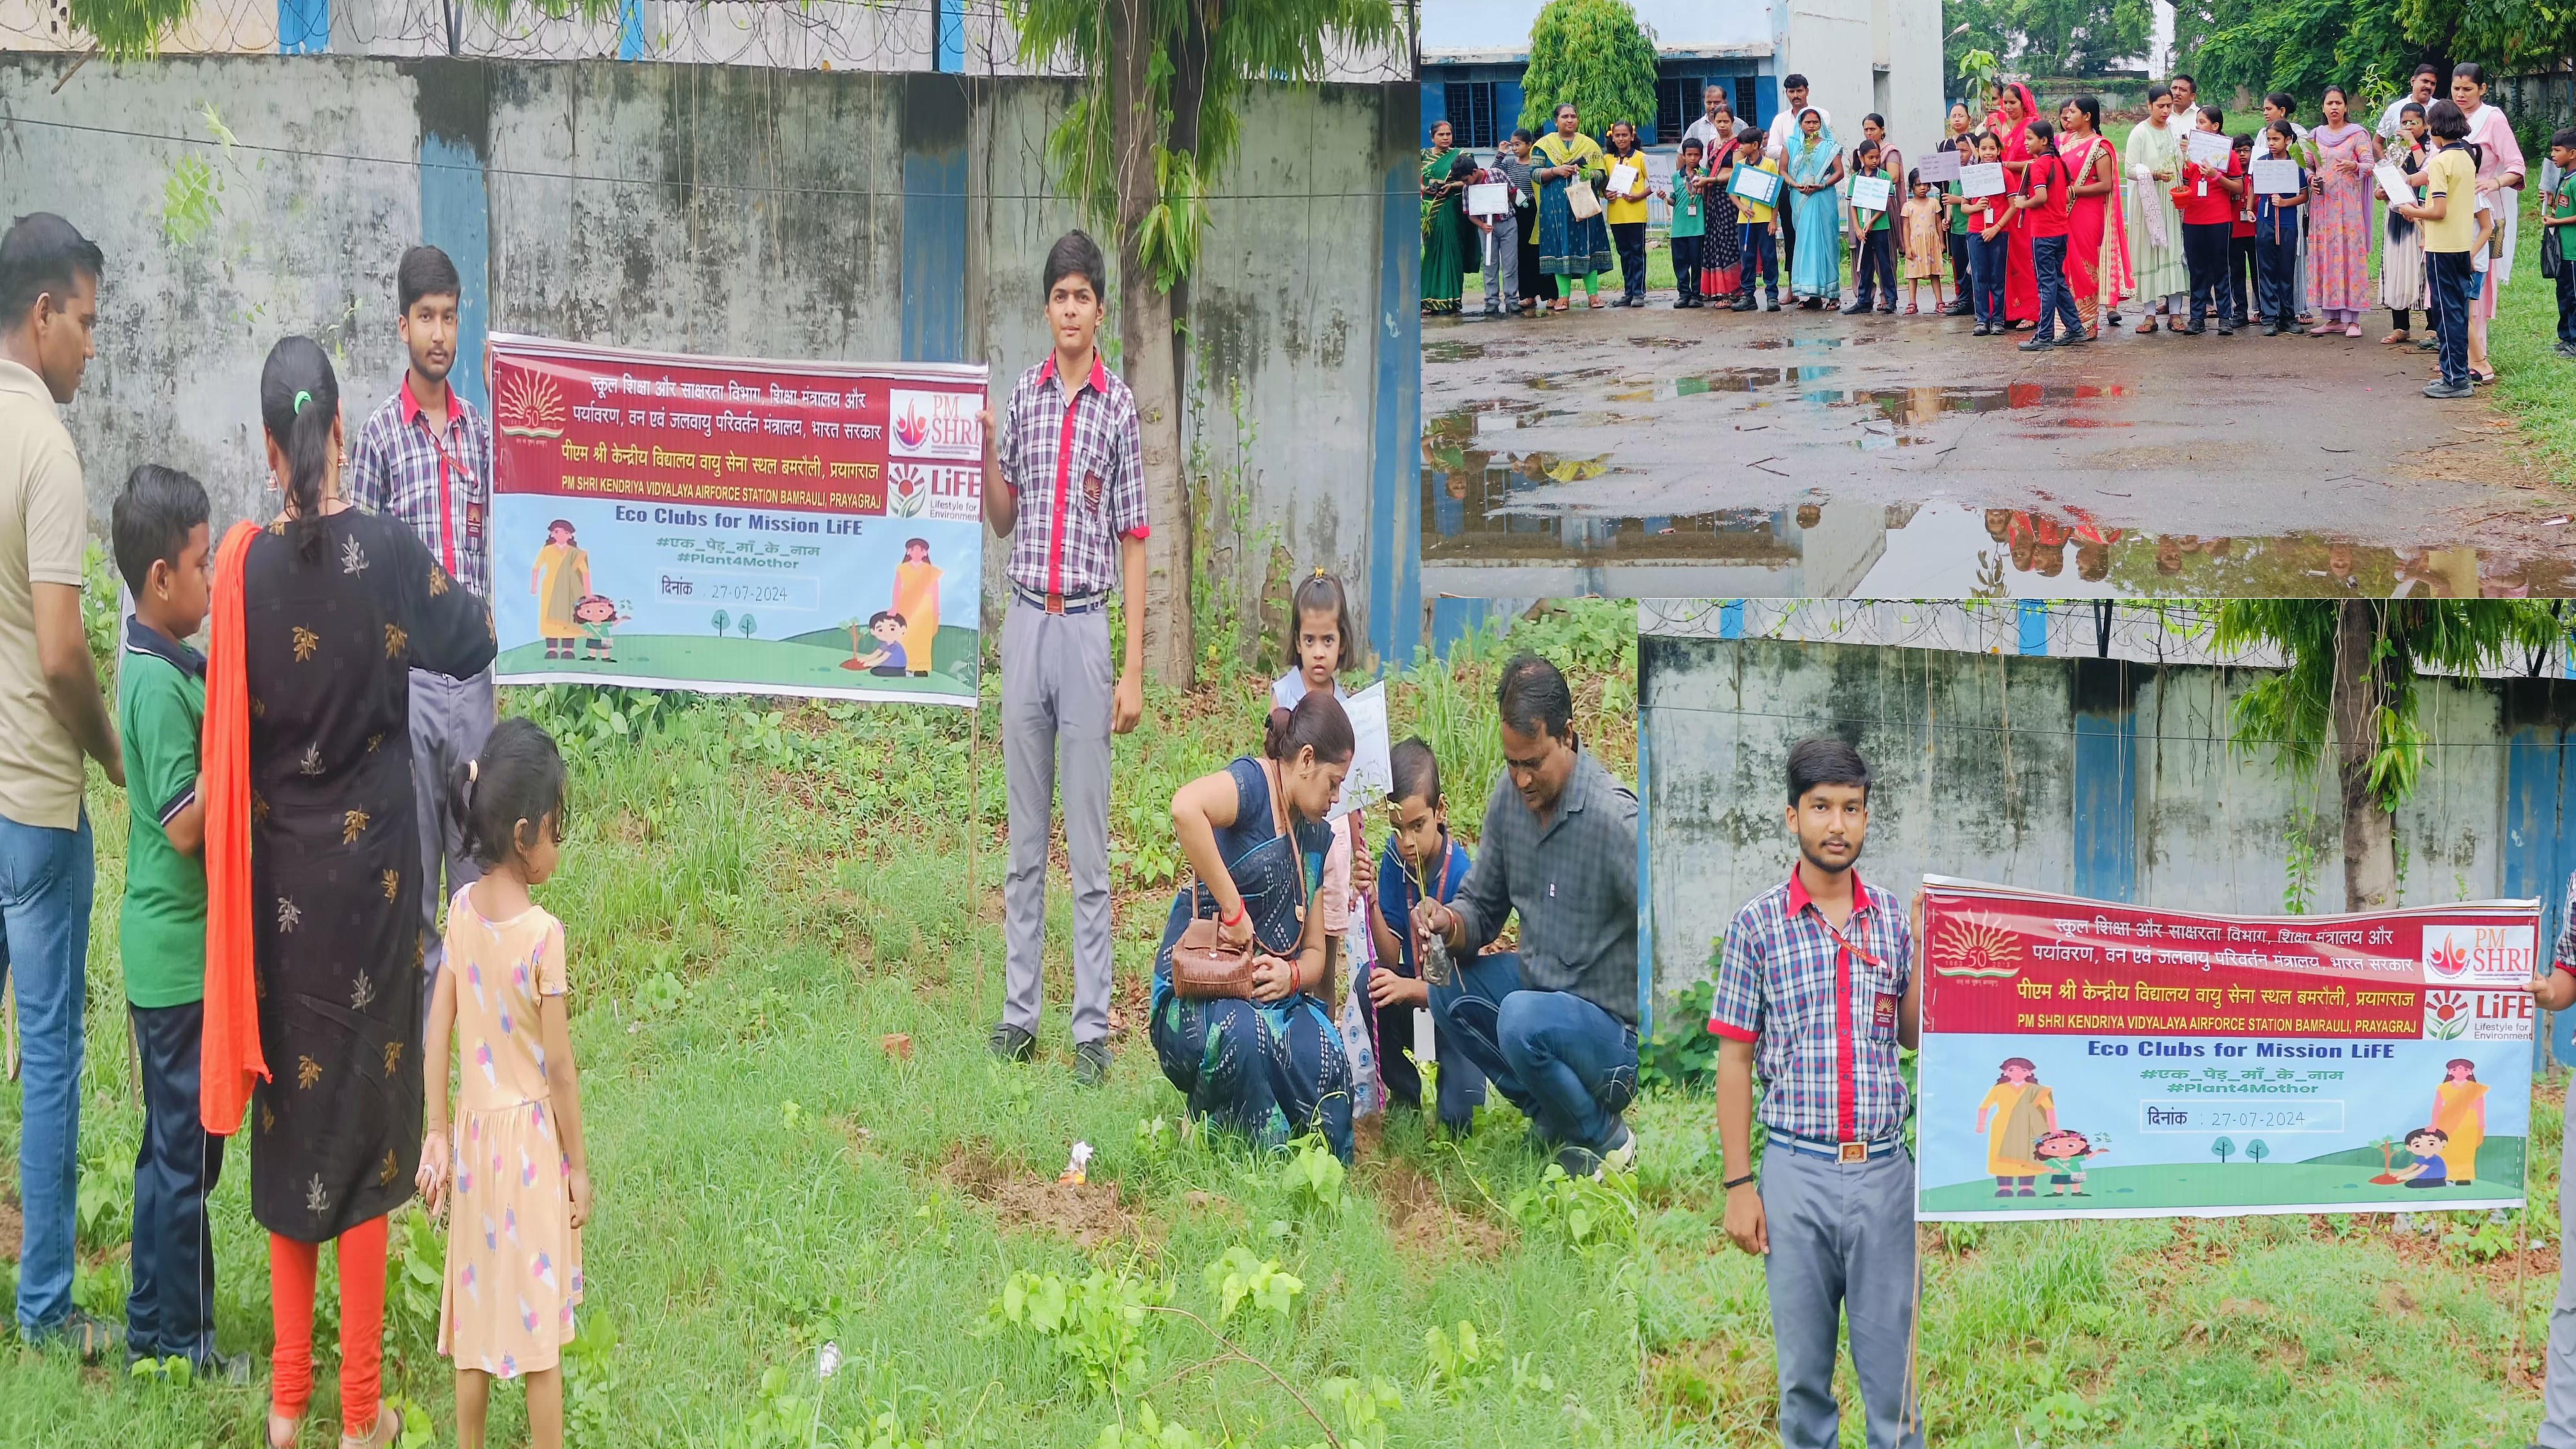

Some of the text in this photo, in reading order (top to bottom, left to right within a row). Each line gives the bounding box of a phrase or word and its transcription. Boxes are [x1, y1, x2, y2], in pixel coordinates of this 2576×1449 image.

[590, 372, 866, 409] स्कूल शिक्षा और साक्षरता विभाग, शिक्षा मंत्रालय और
[525, 409, 539, 426] 50
[933, 394, 960, 418] PM
[573, 401, 624, 428] पर्यावरण,
[628, 409, 645, 426] वन
[650, 406, 665, 428] एवं
[669, 413, 712, 437] जलवायु
[716, 409, 758, 433] परिवर्तन
[763, 413, 806, 439] मंत्रालय,
[811, 421, 840, 438] भारत
[843, 423, 881, 440] सरकार
[931, 417, 980, 446] SHRI
[562, 438, 588, 462] पीएम
[594, 441, 608, 464] श्री
[611, 443, 648, 466] केन्द्रीय
[652, 445, 696, 470] विद्यालय
[699, 454, 721, 477] वायु
[725, 449, 748, 473] सेना
[752, 457, 777, 475] स्थल
[782, 454, 825, 479] बमरौली,
[830, 462, 879, 479] प्रयागराज
[562, 475, 881, 509] PM SHRI KENDRIYA VIDYALAYA AIRFORCE STATION BAMRAULI, PRAYAGRAJ
[931, 468, 981, 497] LiFE
[930, 500, 977, 512] Lifestyle for
[616, 505, 863, 536] Eco Clubs for Mission LiFE
[662, 575, 788, 602] दिनांक 27-07-2024
[2053, 915, 2394, 945] स्कूल शिक्षा और साक्षरता विभाग, शिक्षा मंत्रालय और
[2475, 928, 2506, 948] PM
[1968, 950, 1987, 967] 50
[2033, 940, 2099, 964] पर्यावरण,
[2106, 948, 2126, 963] वन
[2133, 945, 2151, 964] एवं
[2157, 950, 2209, 972] जलवायु
[2214, 948, 2267, 967] परिवर्तन
[2272, 951, 2325, 970] मंत्रालय,
[2330, 956, 2364, 970] भारत
[2368, 958, 2413, 972] सरकार
[2473, 948, 2530, 972] SHRI
[2017, 977, 2415, 1009] पीएम श्री केन्द्रीय विद्यालय वायु सेना स्थल बमरौली, प्रयागराज
[2476, 994, 2533, 1019] LiFE
[2018, 1014, 2416, 1034] PM SHRI KENDRIYA VIDYALAYA AIRFORCE STATION BAMRAULI, PRAYAGRAJ
[2475, 1023, 2528, 1031] Lifestyle for
[2088, 1041, 2394, 1059] Eco Clubs for Mission LiFE
[2167, 1083, 2318, 1094] #Plant4Mother
[2148, 1107, 2188, 1126] दिनांक
[2211, 1112, 2306, 1126] 27-07-2024
